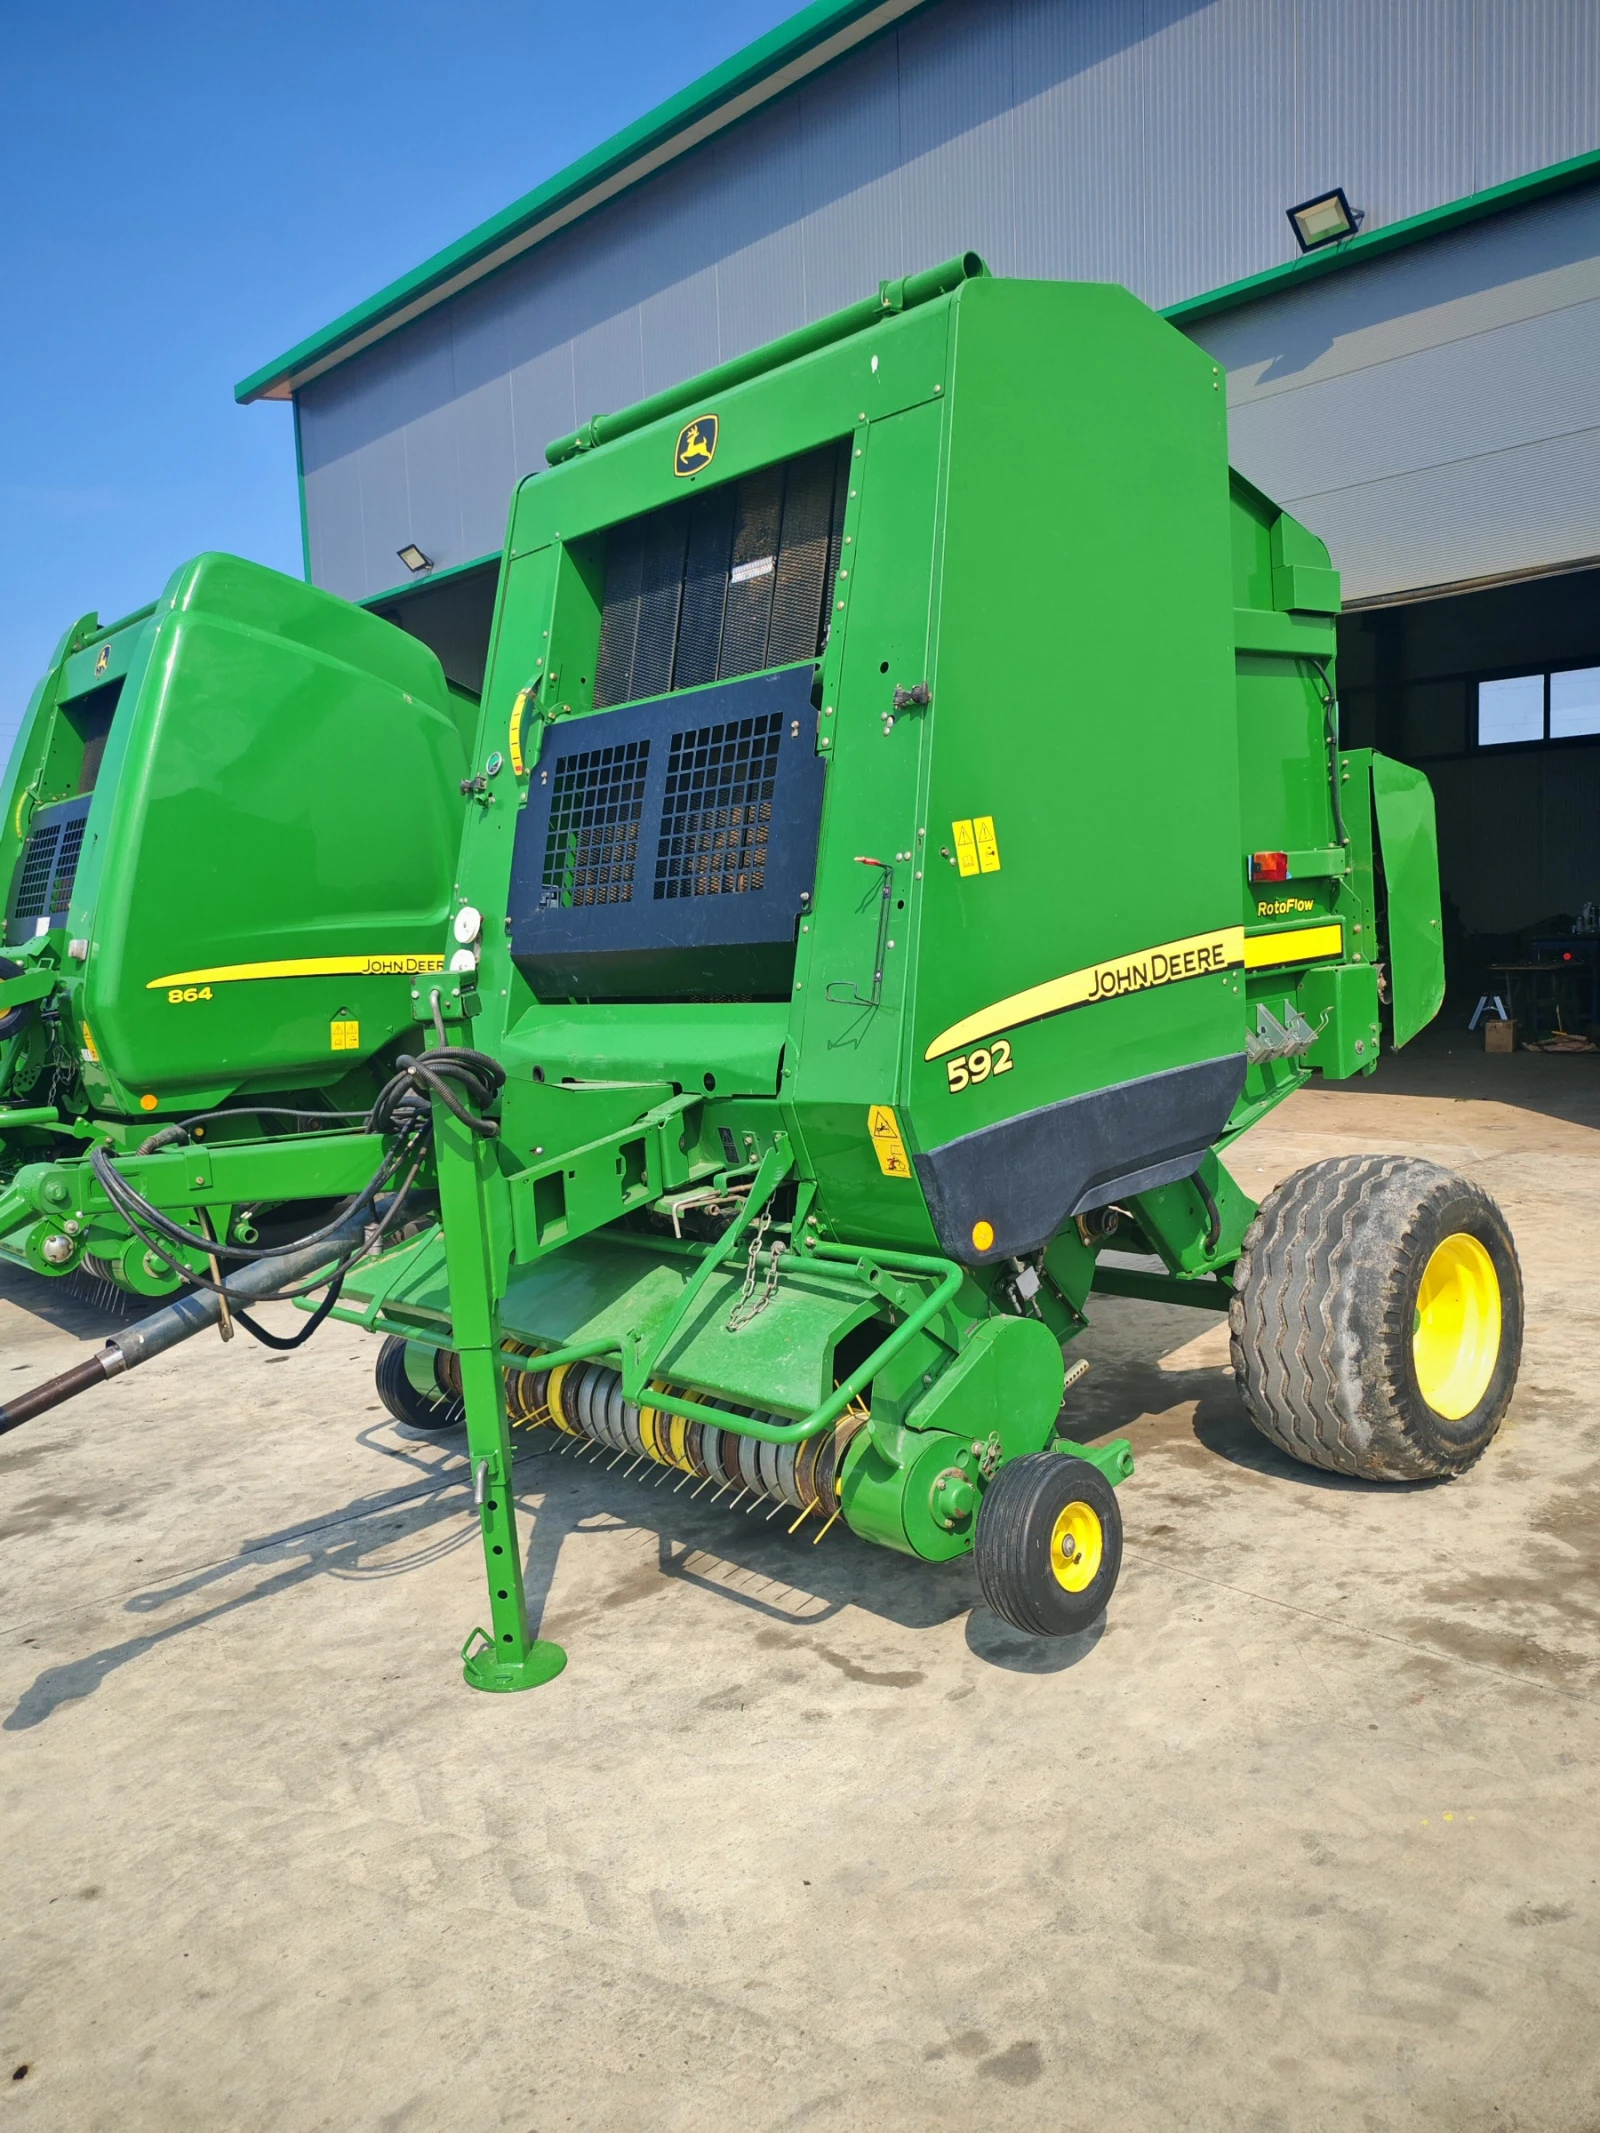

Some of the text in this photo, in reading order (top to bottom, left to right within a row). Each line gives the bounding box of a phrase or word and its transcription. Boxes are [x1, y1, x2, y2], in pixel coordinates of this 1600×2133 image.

[1257, 897, 1315, 917] RotoFlow
[362, 958, 445, 973] JOHN DEER
[1088, 943, 1226, 998] JOHN DEERE
[168, 986, 214, 1004] 864
[946, 1038, 1015, 1094] 592
